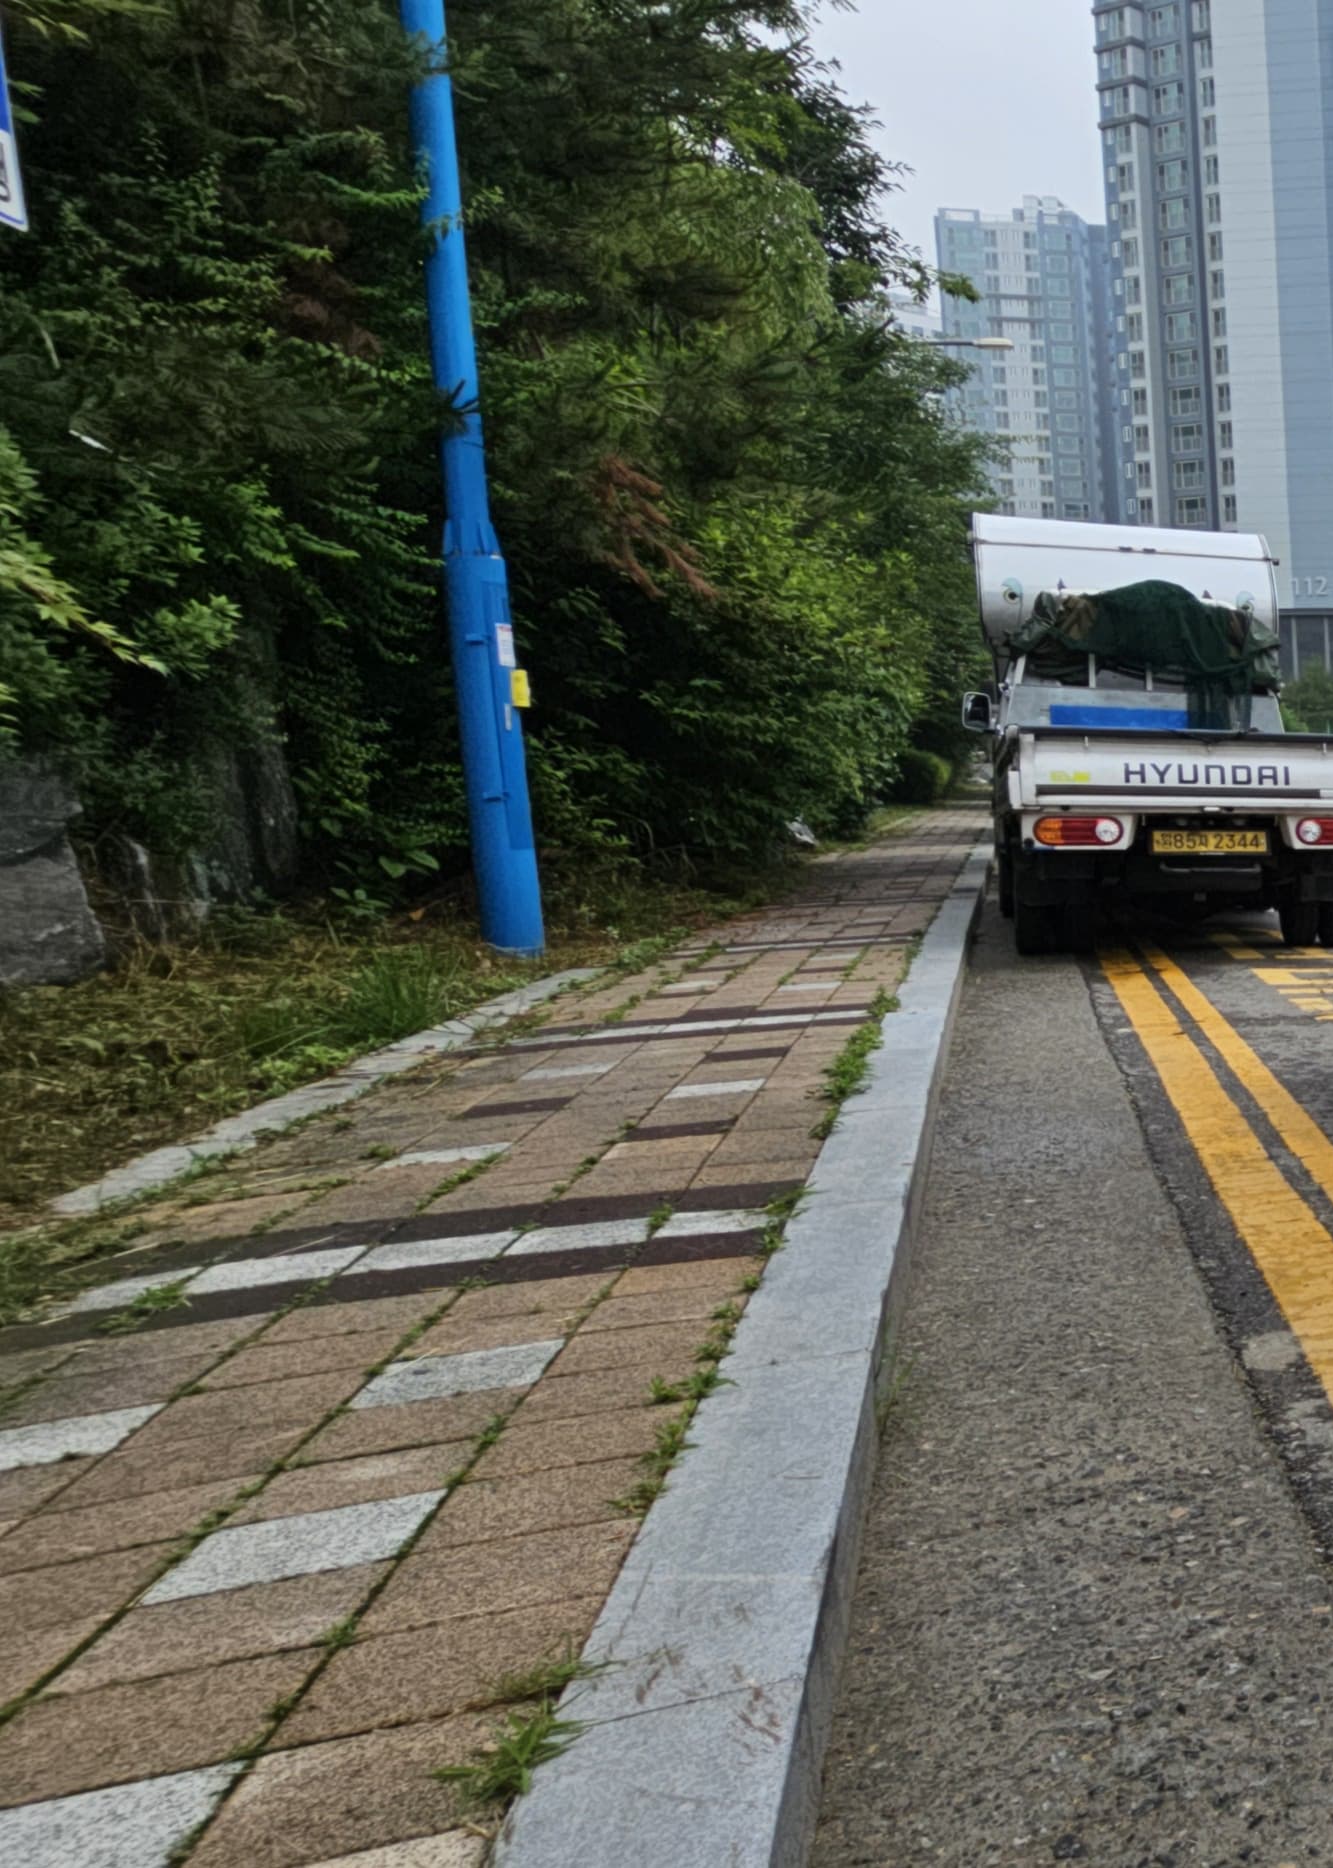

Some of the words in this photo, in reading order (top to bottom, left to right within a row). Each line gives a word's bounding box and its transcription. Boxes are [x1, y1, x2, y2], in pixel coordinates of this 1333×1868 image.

[1291, 576, 1329, 596] 112
[1123, 762, 1291, 787] HYUNDAI
[1213, 833, 1261, 850] 2344
